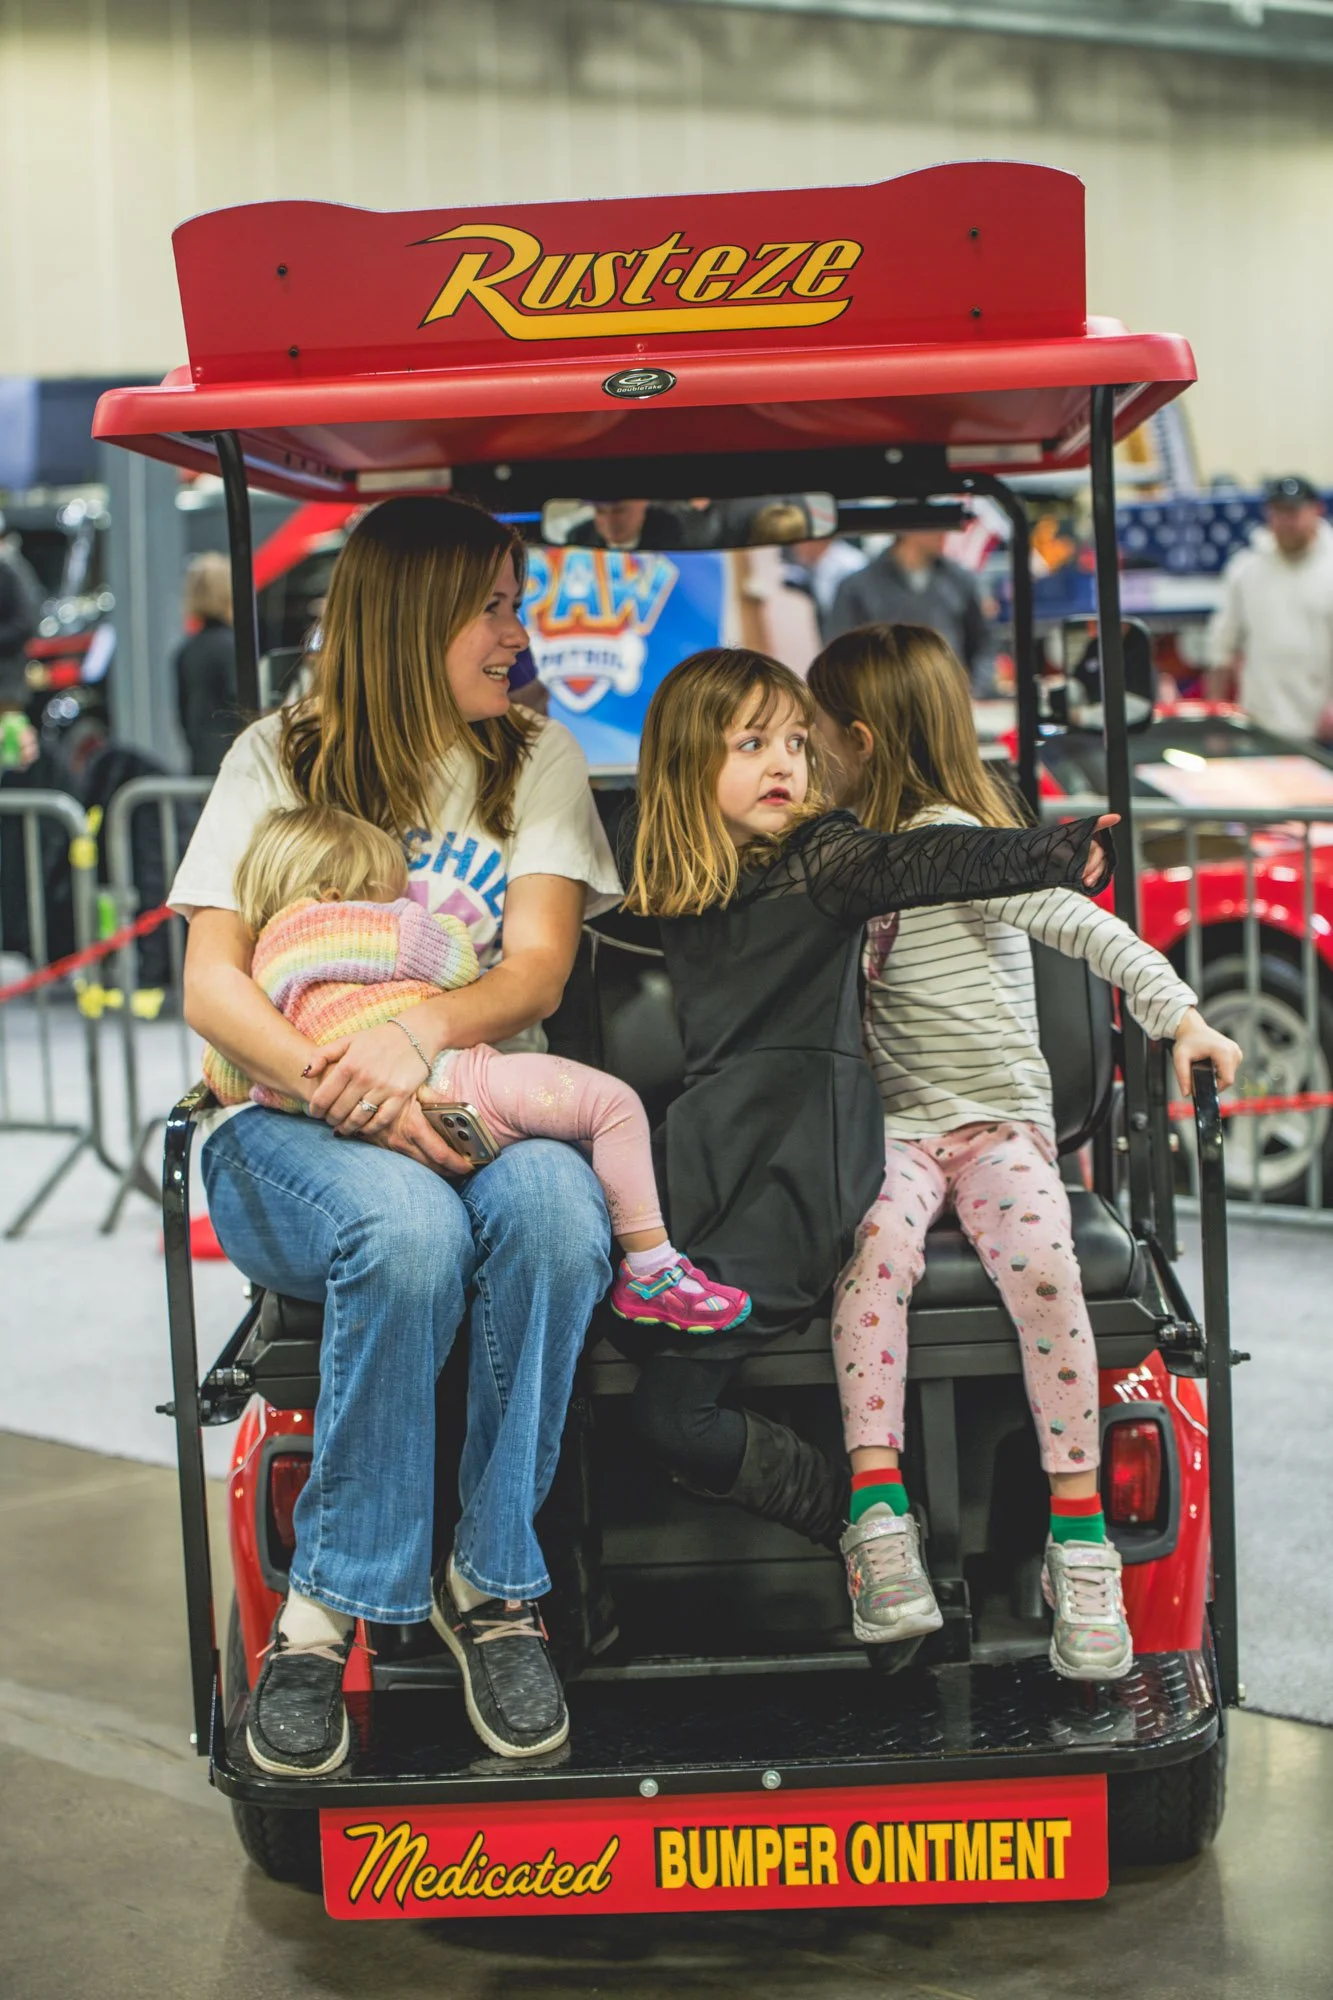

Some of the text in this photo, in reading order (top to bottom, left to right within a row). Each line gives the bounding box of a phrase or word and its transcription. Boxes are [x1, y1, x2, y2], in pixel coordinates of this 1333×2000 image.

[519, 549, 679, 637] PAW
[404, 827, 508, 922] CHIL
[343, 1819, 1072, 1910] Medicated BUMPER OINTMENT
